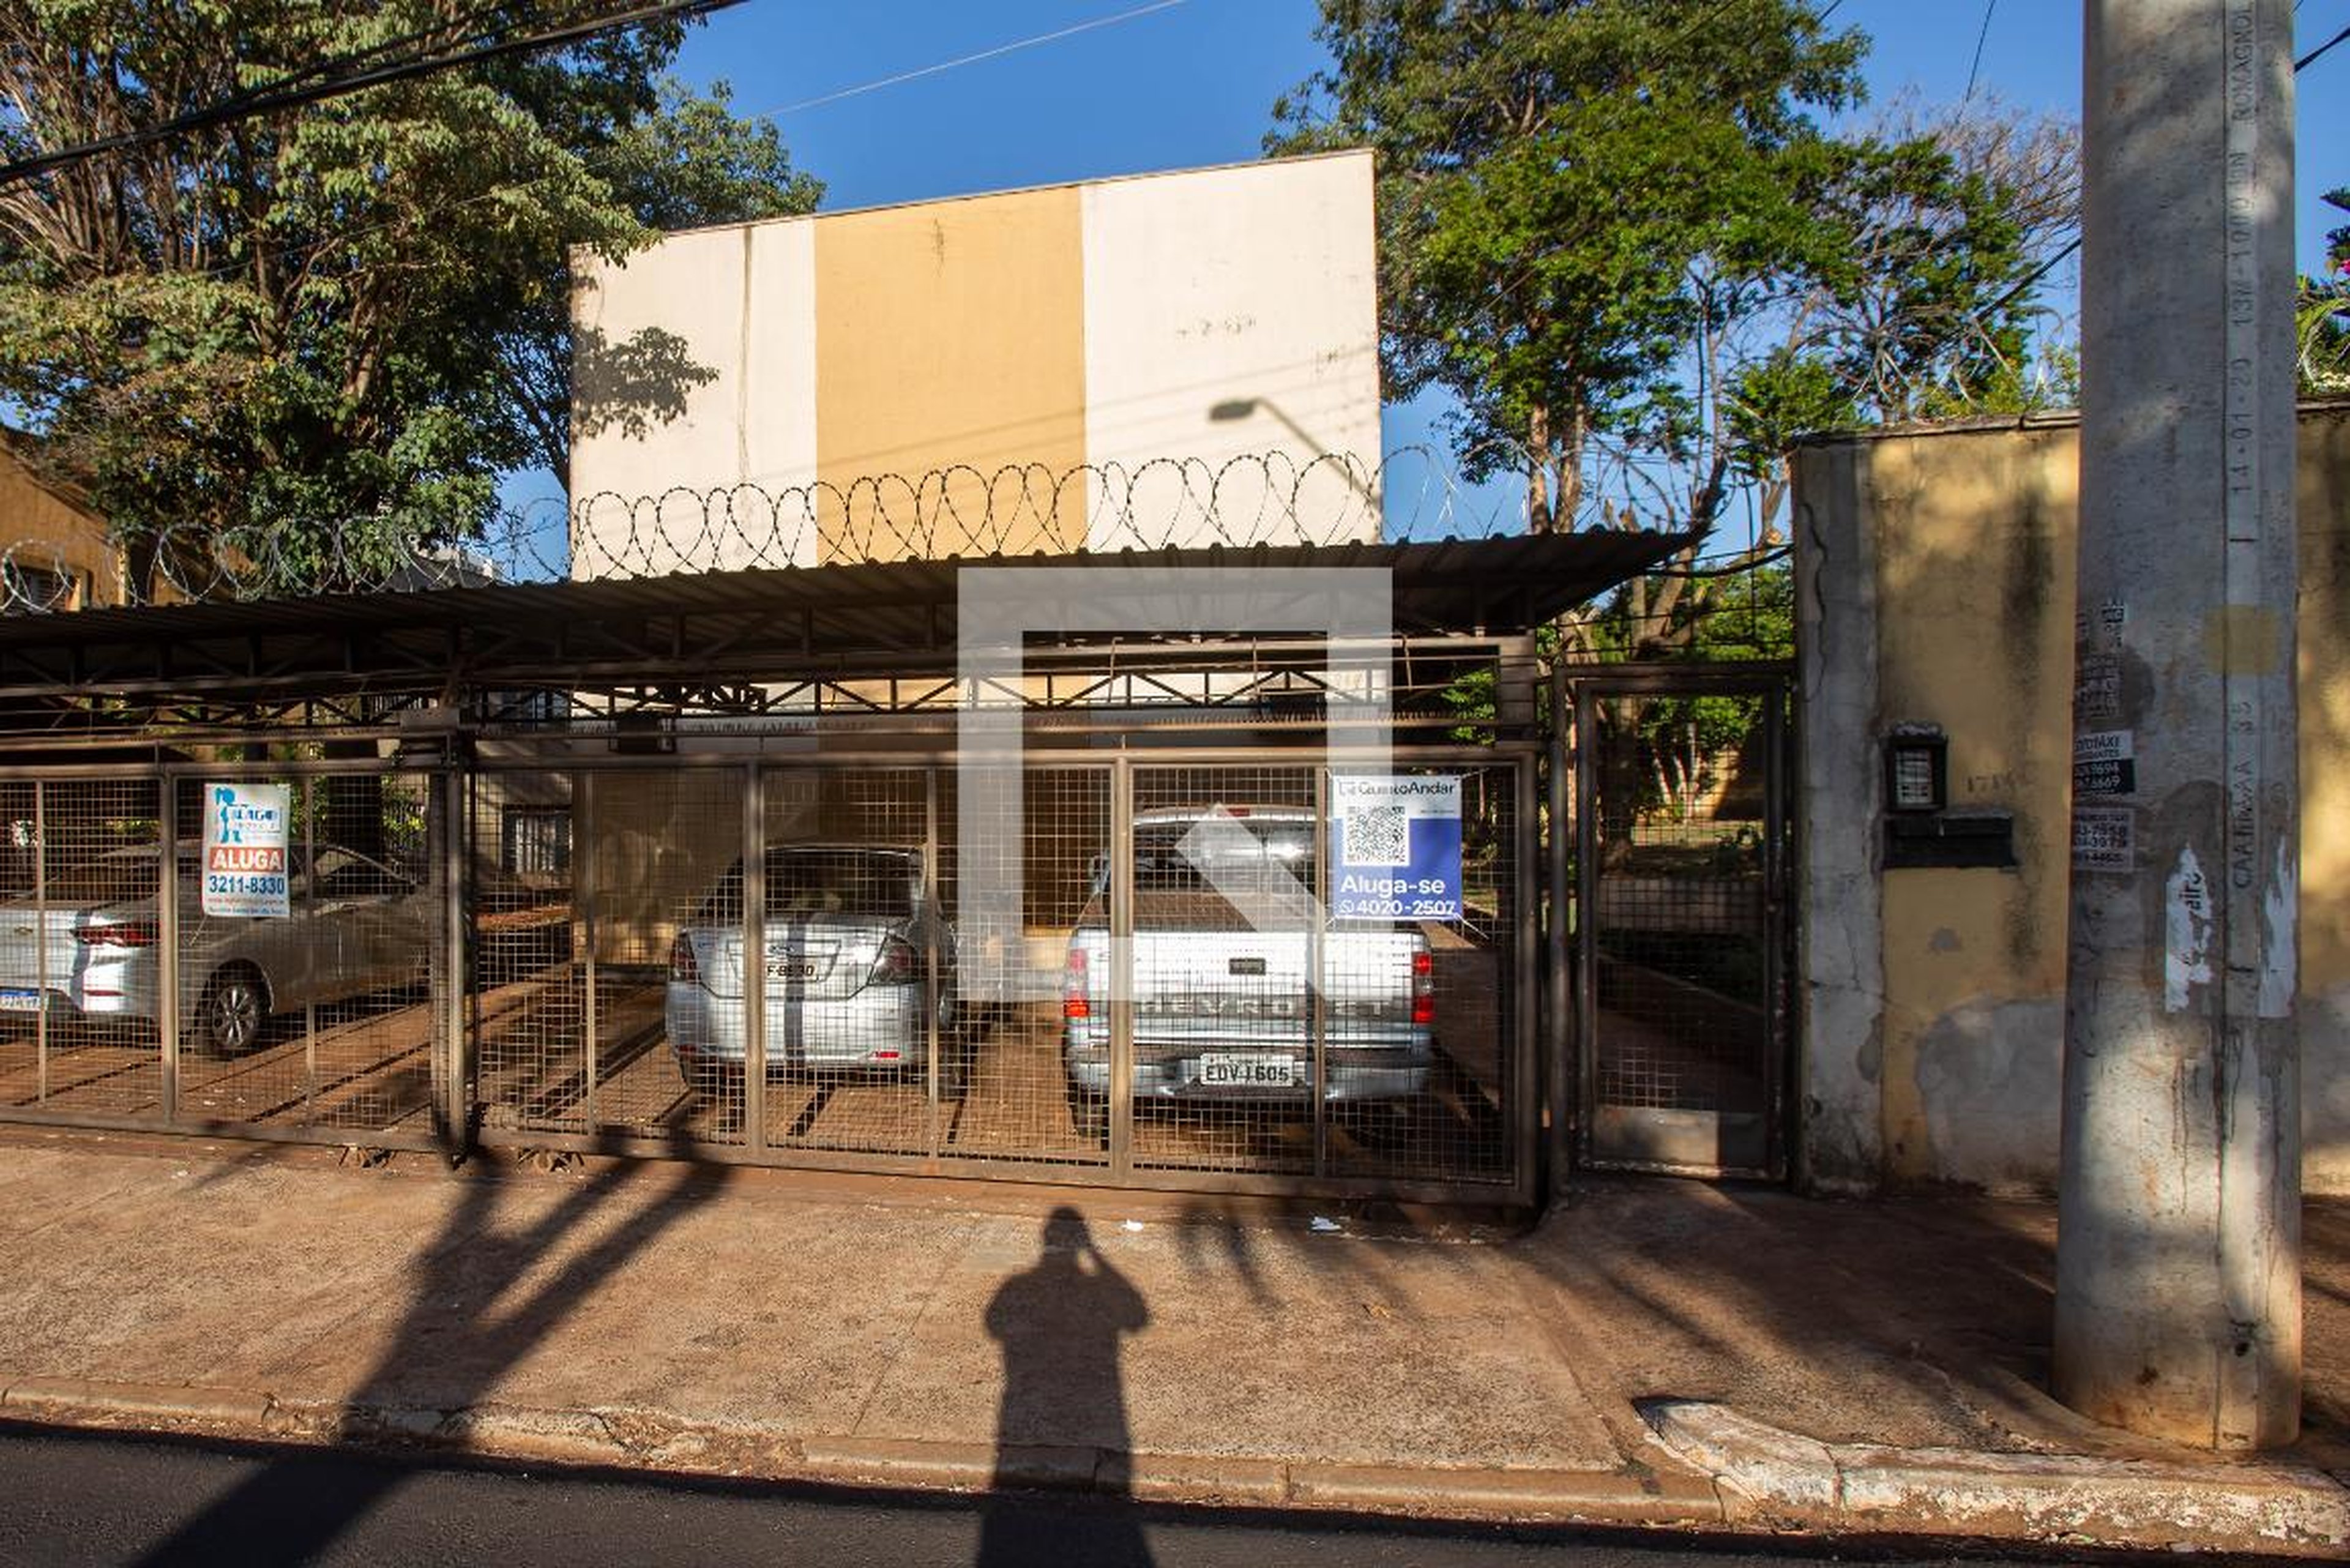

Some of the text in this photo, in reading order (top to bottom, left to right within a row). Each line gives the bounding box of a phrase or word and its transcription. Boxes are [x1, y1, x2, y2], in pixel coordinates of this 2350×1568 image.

[212, 850, 282, 870] ALUGA
[209, 876, 285, 894] 3211-8330
[1340, 875, 1446, 899] Aluga-se
[1357, 900, 1456, 915] 4020-2507
